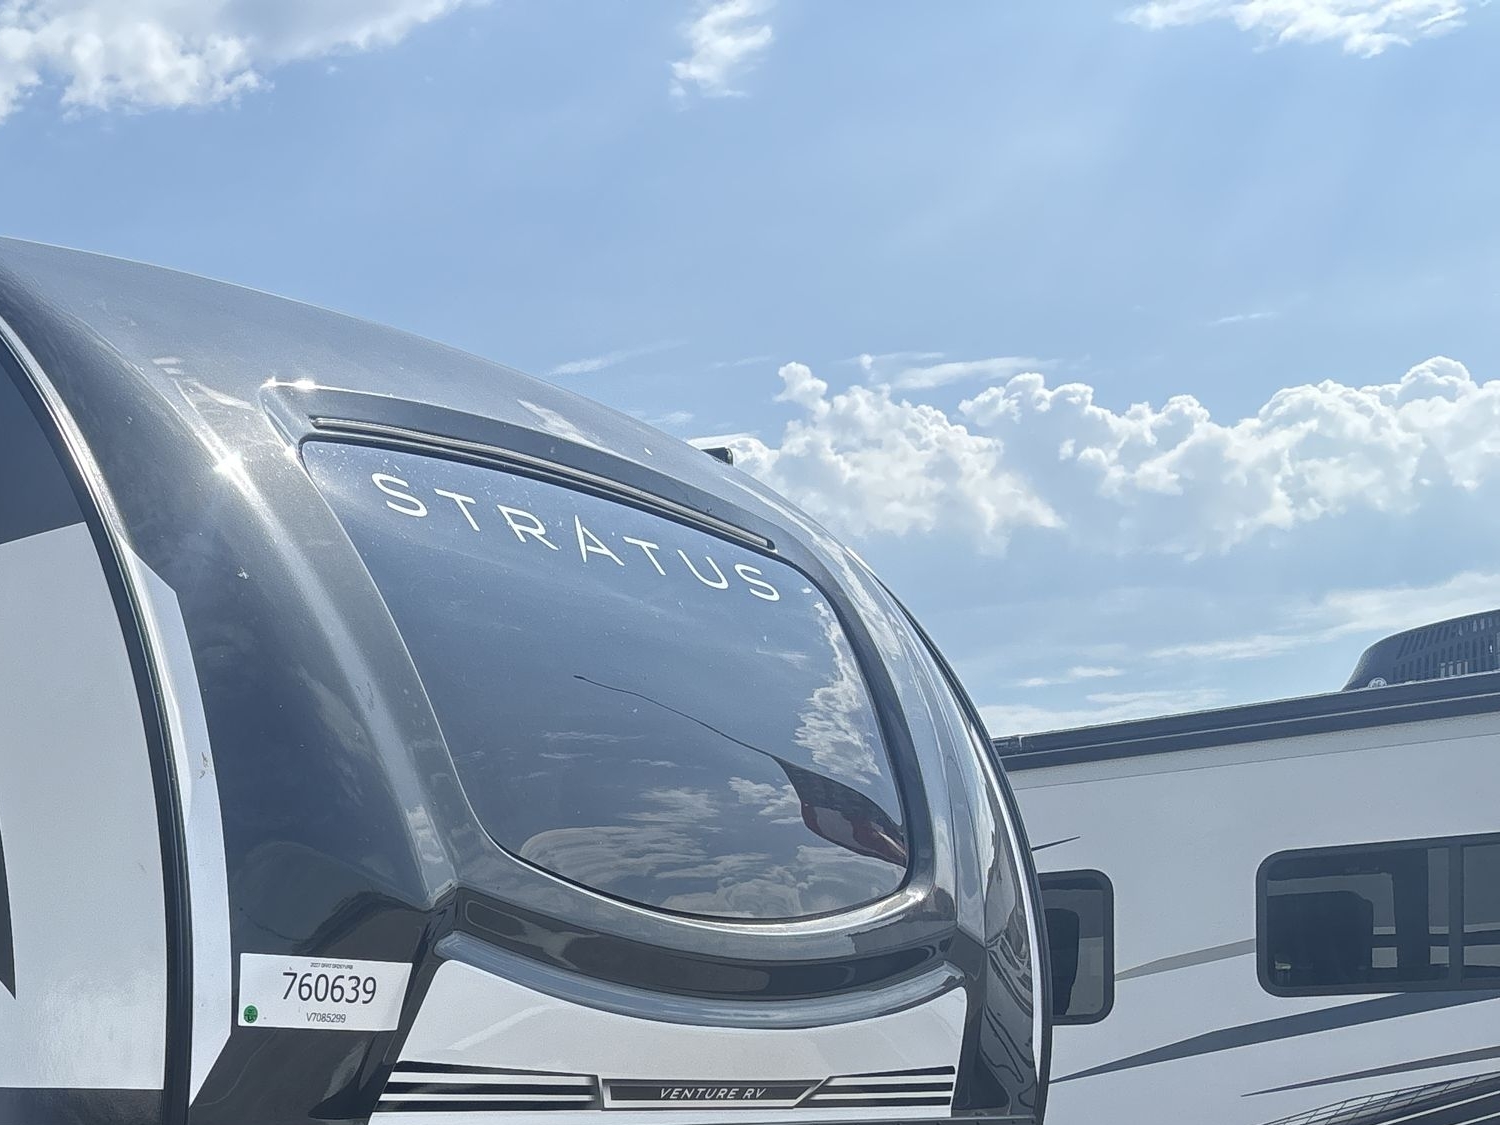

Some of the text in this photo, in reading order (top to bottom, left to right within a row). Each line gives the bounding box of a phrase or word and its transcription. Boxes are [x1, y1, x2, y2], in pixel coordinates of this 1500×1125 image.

[371, 472, 780, 602] STRATUS
[282, 971, 377, 1005] 760639
[306, 1012, 346, 1024] V7085299
[659, 1087, 767, 1100] VENTURE RV
